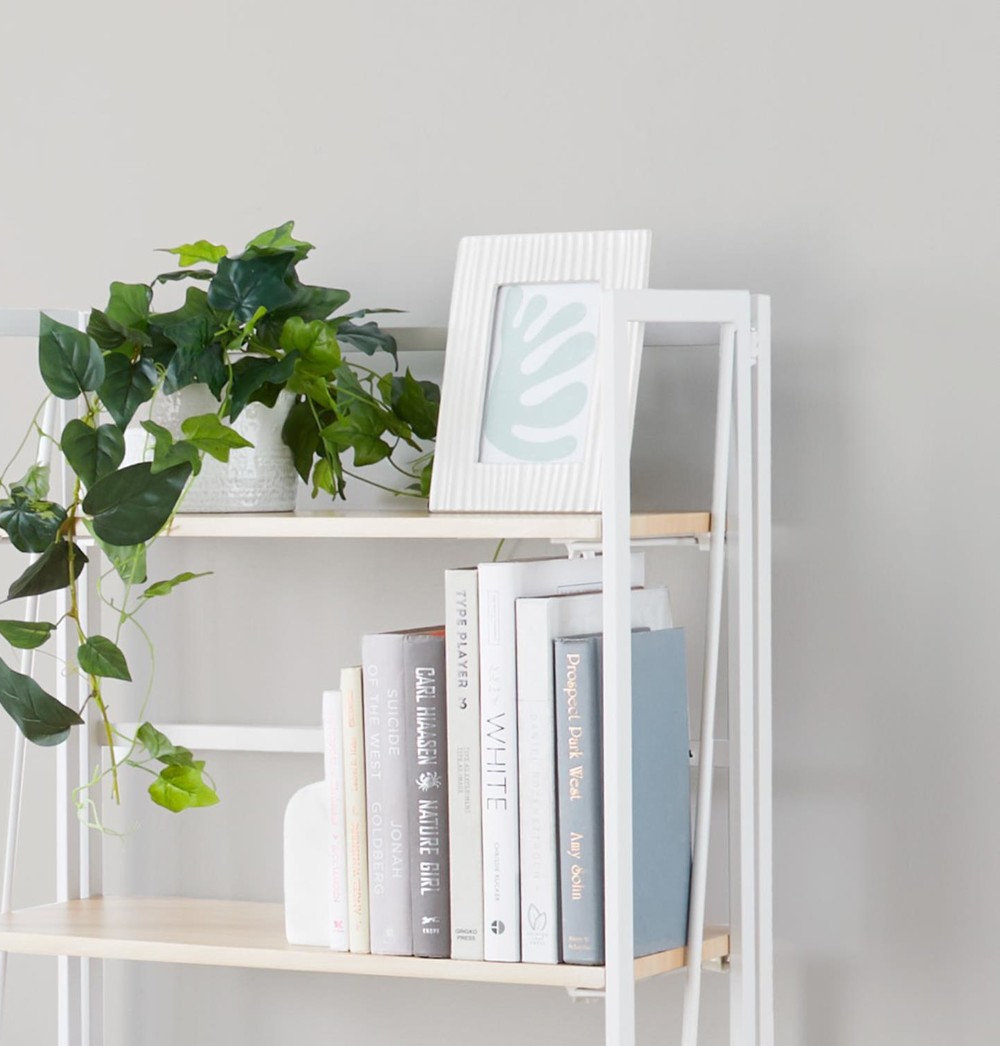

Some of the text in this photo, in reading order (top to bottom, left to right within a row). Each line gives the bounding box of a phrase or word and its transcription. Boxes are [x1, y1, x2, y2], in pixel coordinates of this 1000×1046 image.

[456, 590, 467, 626] TYPE
[457, 631, 469, 688] PLAYER
[366, 664, 382, 781] OF THE WEST
[386, 688, 400, 757] SUICIDE
[415, 667, 438, 766] CARL HIAASEN
[487, 712, 507, 811] WHITE
[563, 653, 583, 801] Prospect Park West
[371, 801, 385, 896] GOLDBERG
[390, 819, 403, 879] JONAH
[418, 799, 441, 896] NATURE GIRL
[567, 831, 584, 859] Amy
